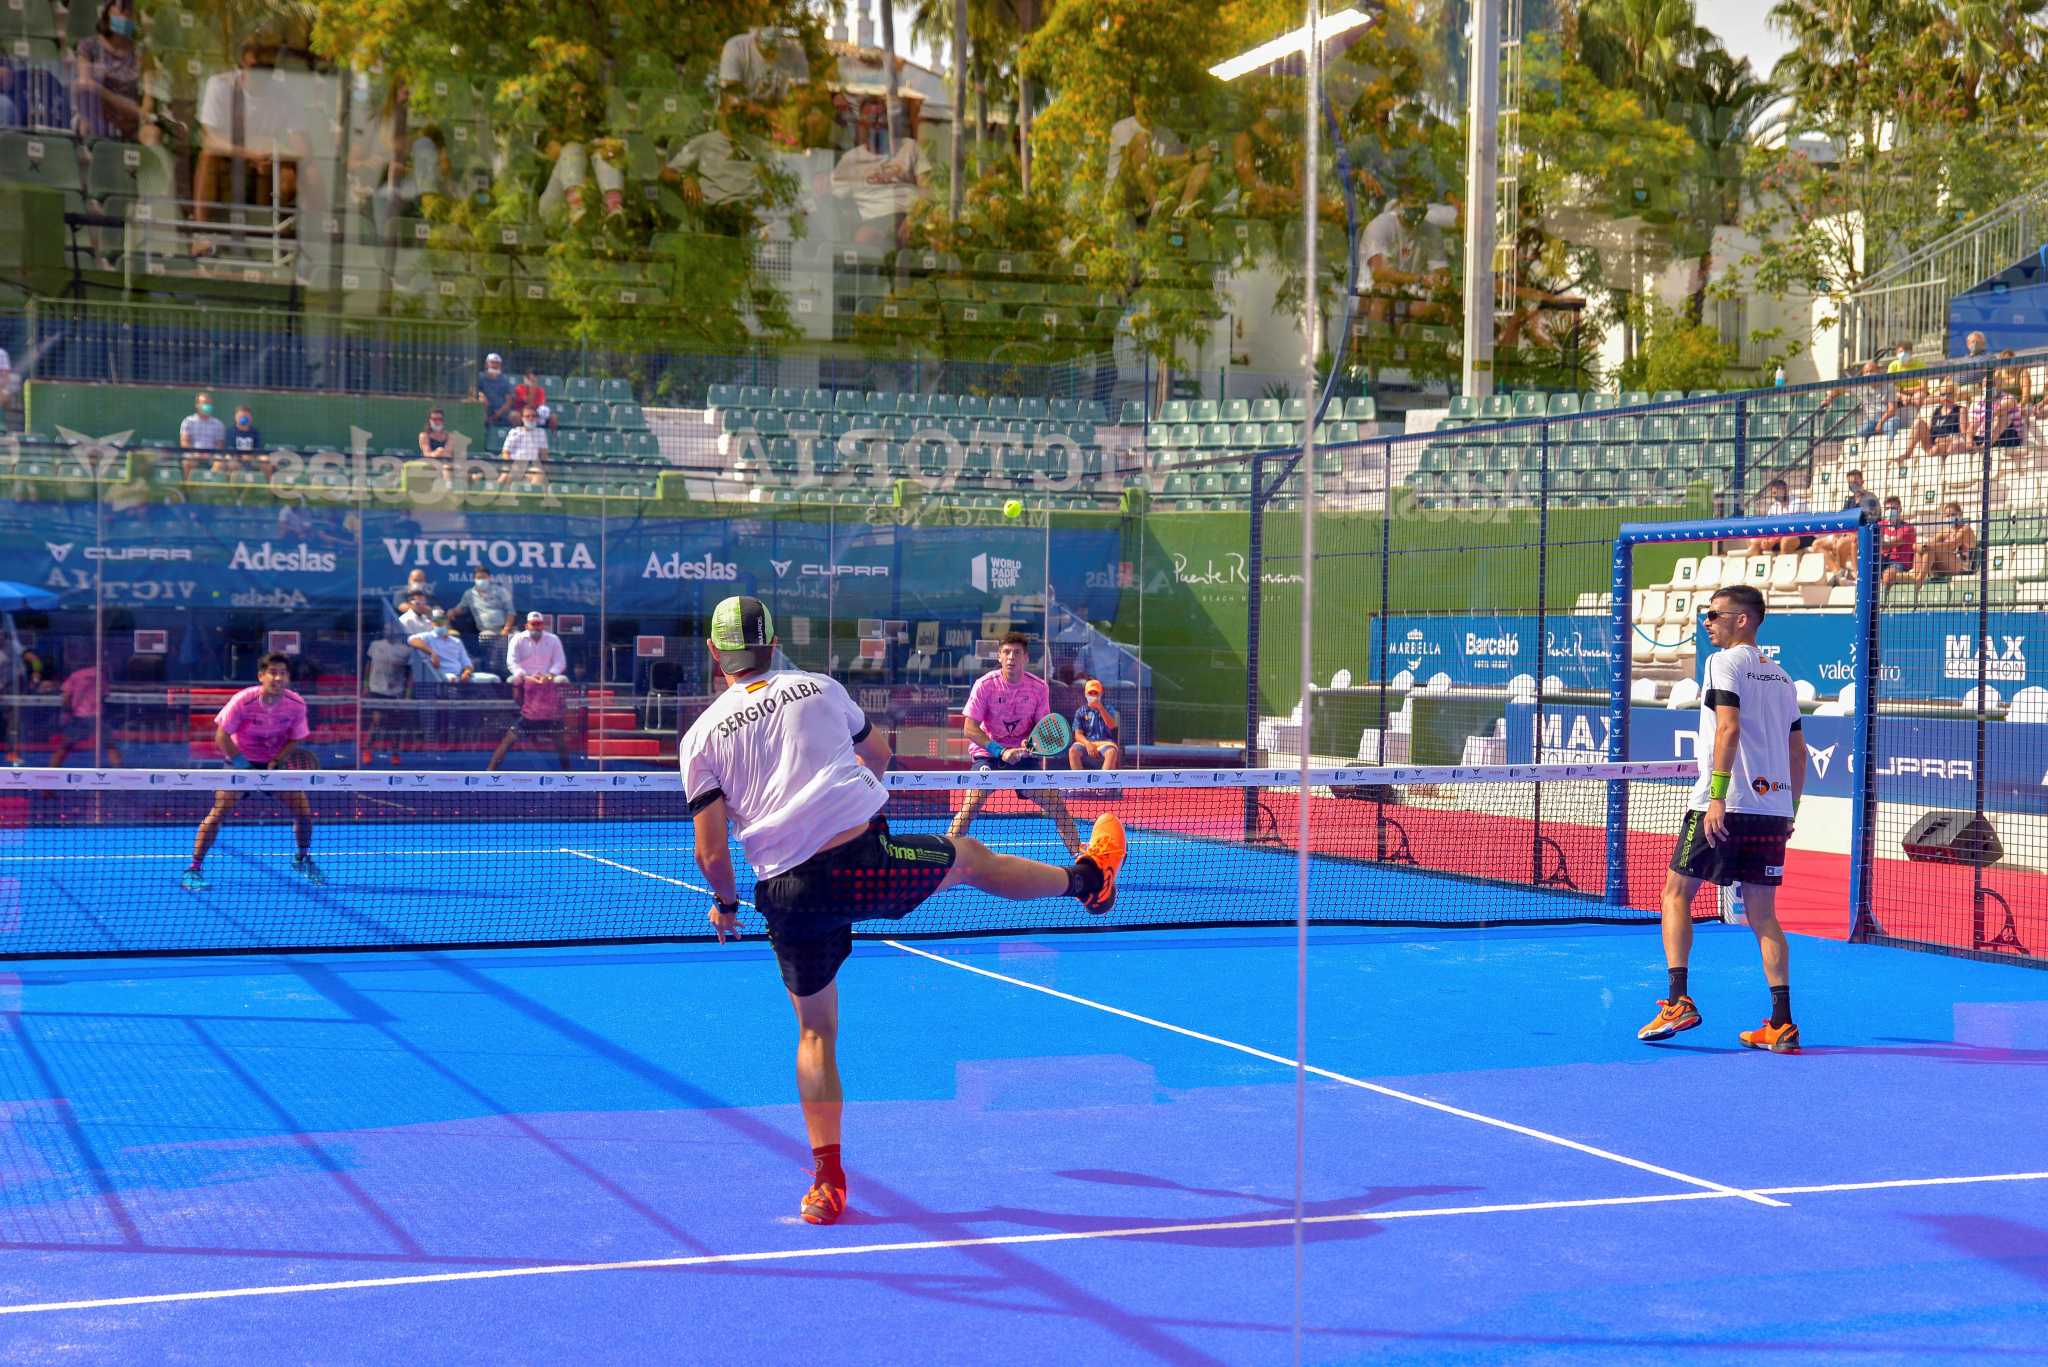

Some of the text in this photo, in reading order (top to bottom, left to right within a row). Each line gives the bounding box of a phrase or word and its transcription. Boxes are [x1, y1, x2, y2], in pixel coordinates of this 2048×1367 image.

[84, 547, 193, 561] CUPRA
[229, 541, 336, 573] Adeslas
[383, 538, 597, 569] VICTORIA
[990, 556, 1022, 569] WORLD
[642, 551, 738, 581] Adeslas
[801, 564, 889, 577] CUPRA
[990, 568, 1020, 579] PADEL
[1173, 552, 1229, 585] Puente
[507, 573, 534, 584] 1928
[990, 577, 1017, 589] TOUR
[1388, 642, 1442, 655] MARBELLA
[1465, 632, 1520, 657] Barceló
[1945, 634, 2025, 660] MAX
[1946, 660, 2024, 678] COLHON
[717, 697, 777, 739] SERGIO
[780, 681, 823, 706] ALBA
[1847, 755, 1975, 780] UPRA
